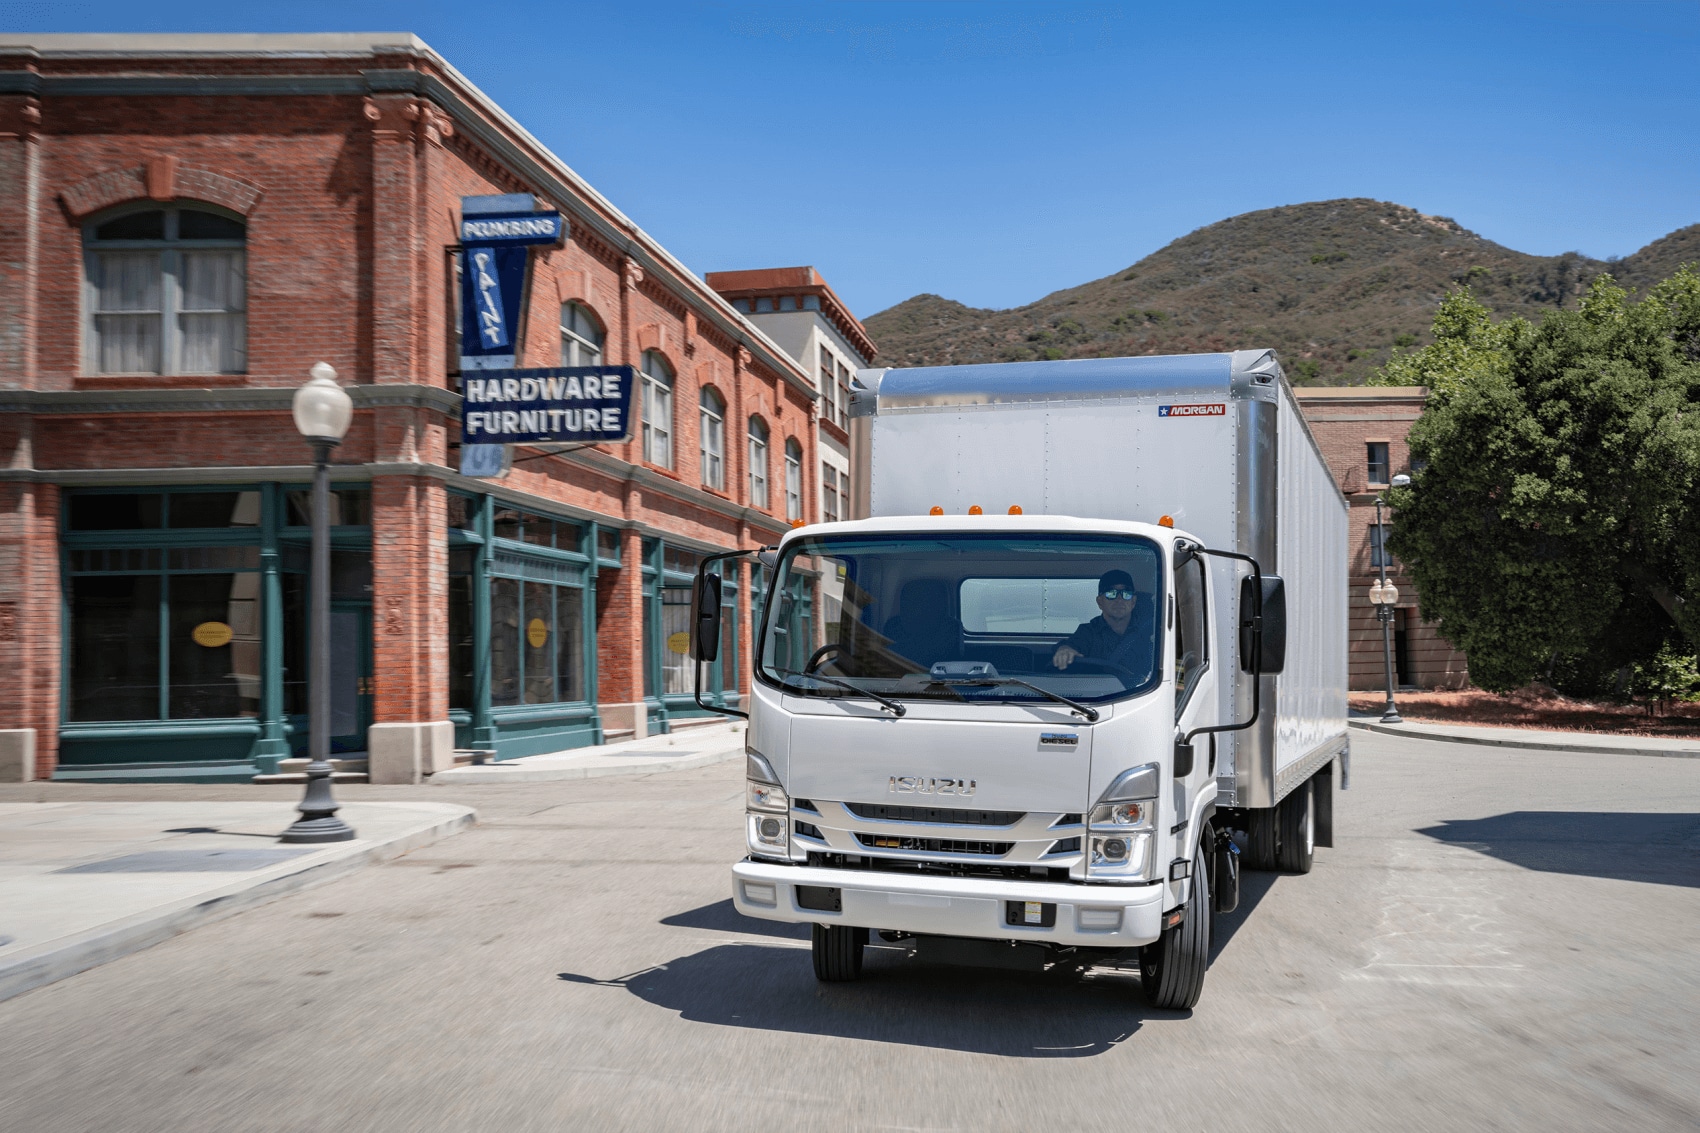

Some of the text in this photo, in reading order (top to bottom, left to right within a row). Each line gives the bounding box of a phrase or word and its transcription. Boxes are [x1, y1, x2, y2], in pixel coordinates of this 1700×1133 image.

[474, 252, 502, 345] PAINT
[466, 375, 622, 402] HARDWARE
[466, 407, 622, 434] FURNITURE
[1170, 405, 1223, 415] MORGAN
[889, 776, 977, 796] ISUZU
